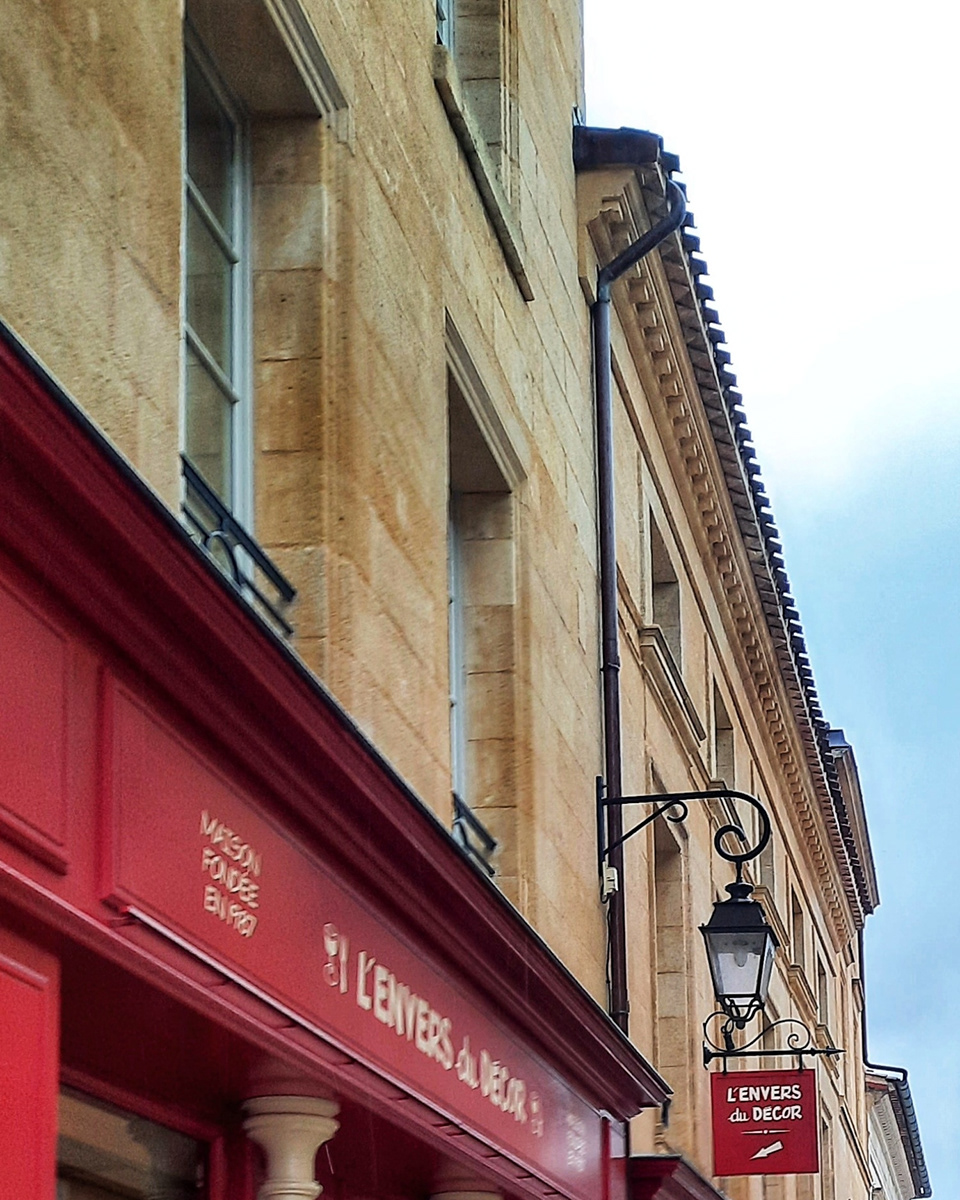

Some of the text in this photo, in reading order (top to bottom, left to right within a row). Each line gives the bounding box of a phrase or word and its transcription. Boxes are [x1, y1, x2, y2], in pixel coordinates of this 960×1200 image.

[200, 809, 262, 877] MAISON
[357, 951, 455, 1071] L'ENVERS
[727, 1084, 802, 1102] L'ENVERS
[728, 1108, 750, 1122] du
